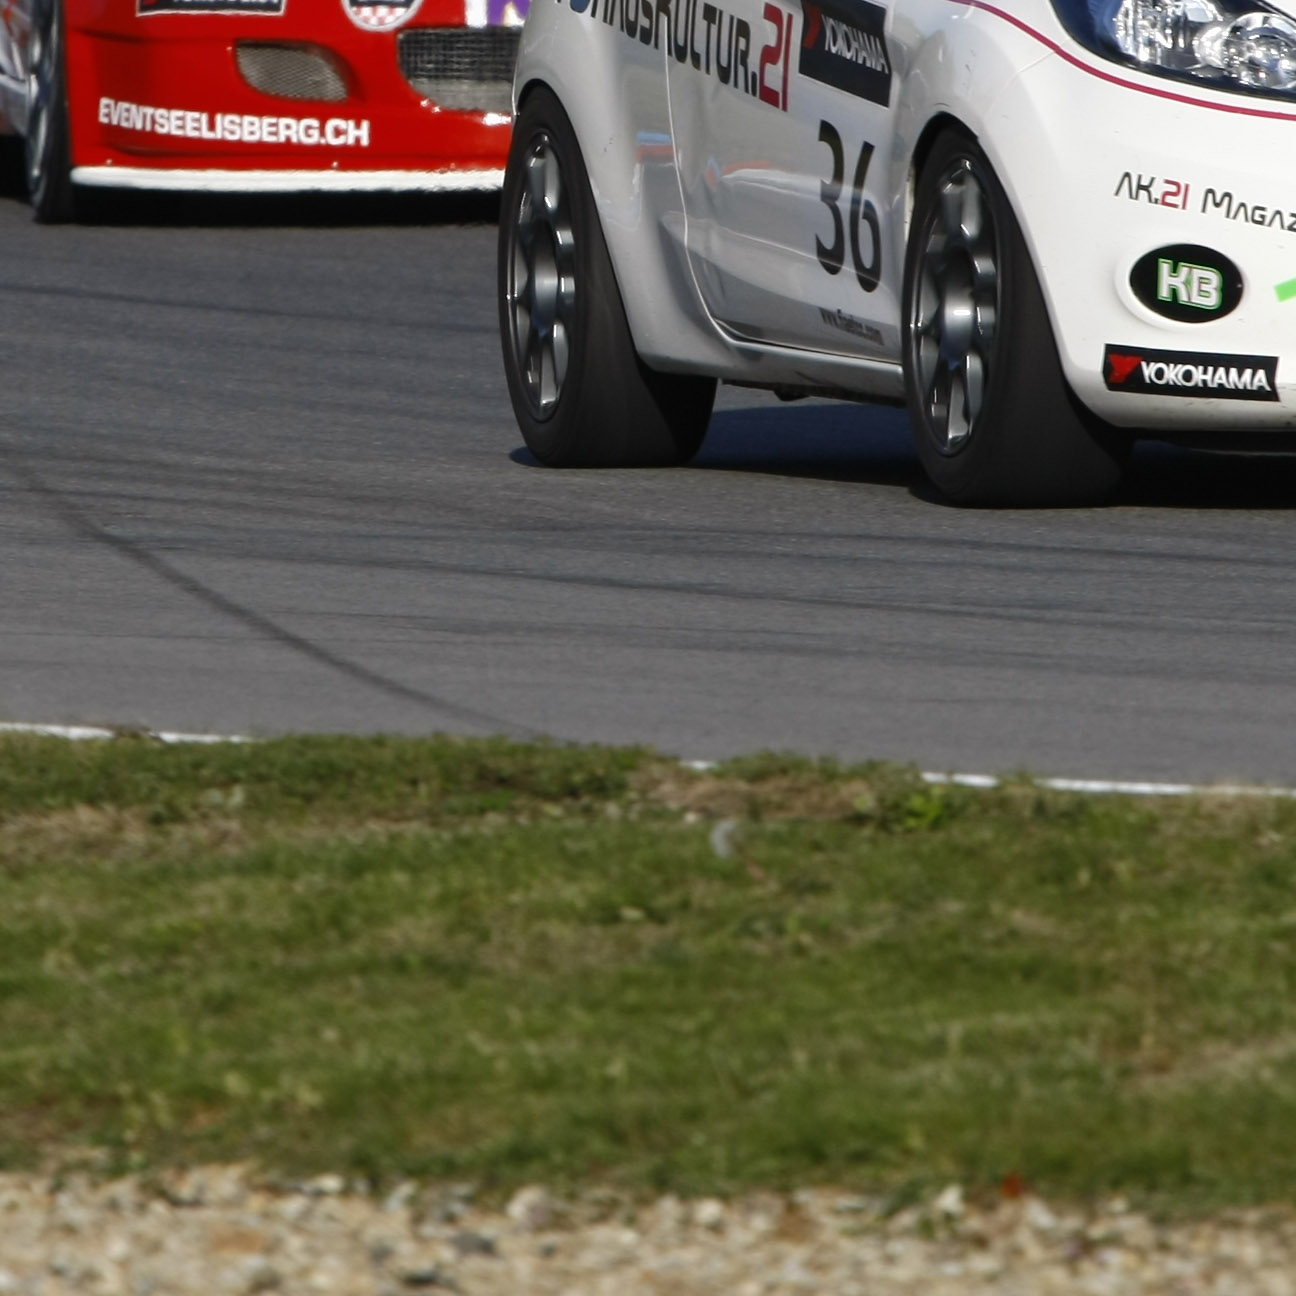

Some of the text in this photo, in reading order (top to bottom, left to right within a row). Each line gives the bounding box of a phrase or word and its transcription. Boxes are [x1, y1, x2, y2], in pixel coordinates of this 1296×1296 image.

[98, 97, 371, 147] EVENTSEELISBERG.CH
[814, 119, 882, 293] 36
[1113, 171, 1191, 210] AK.21
[1157, 257, 1223, 309] KB
[1140, 360, 1272, 393] YOKOHAMA
